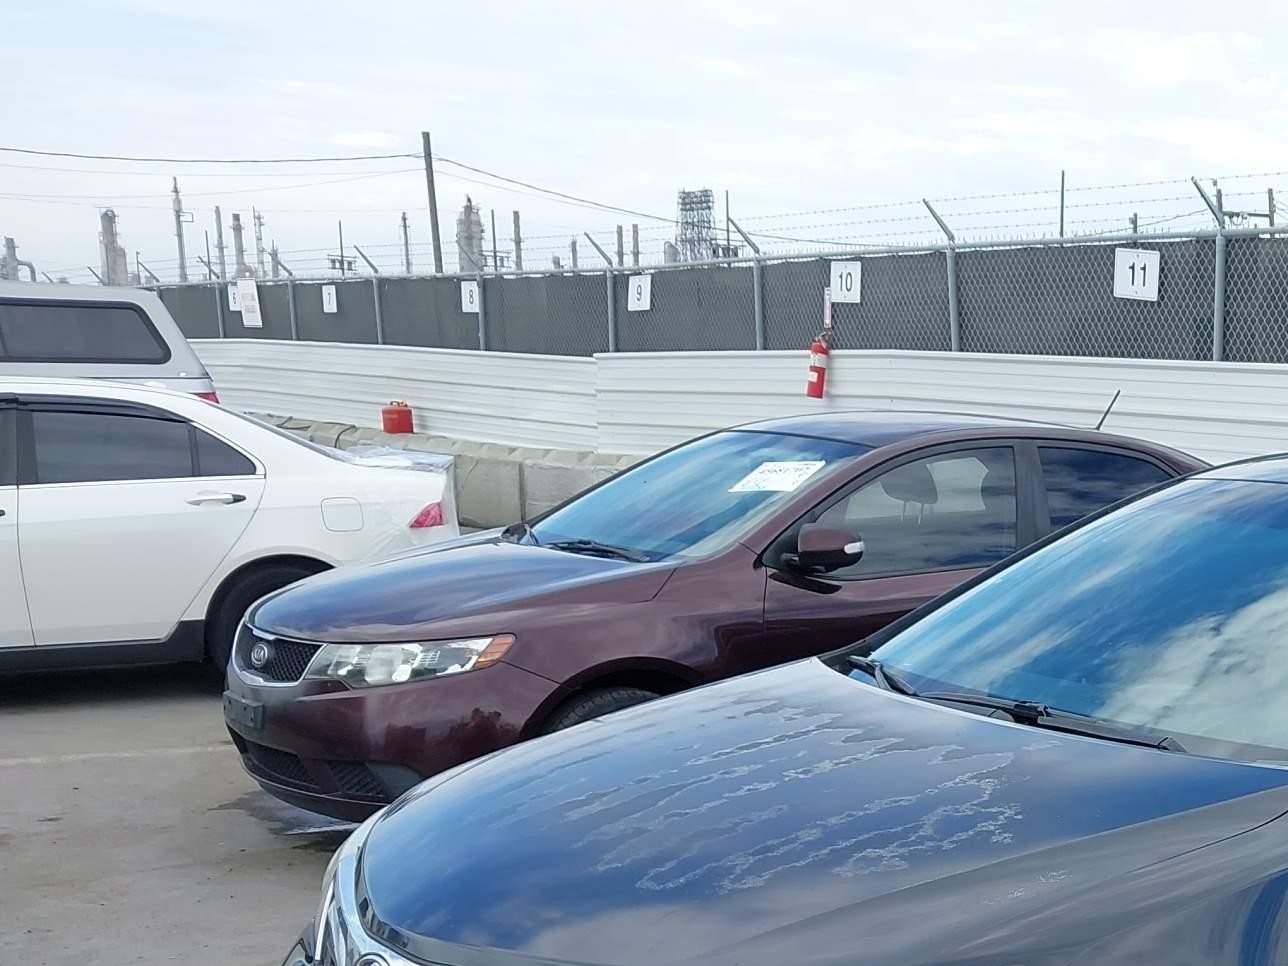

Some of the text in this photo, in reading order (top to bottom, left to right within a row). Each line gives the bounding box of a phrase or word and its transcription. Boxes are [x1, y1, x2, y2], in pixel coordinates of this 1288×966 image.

[837, 271, 854, 293] 10
[1127, 261, 1148, 287] 11
[467, 289, 475, 305] 8
[635, 284, 644, 302] 9
